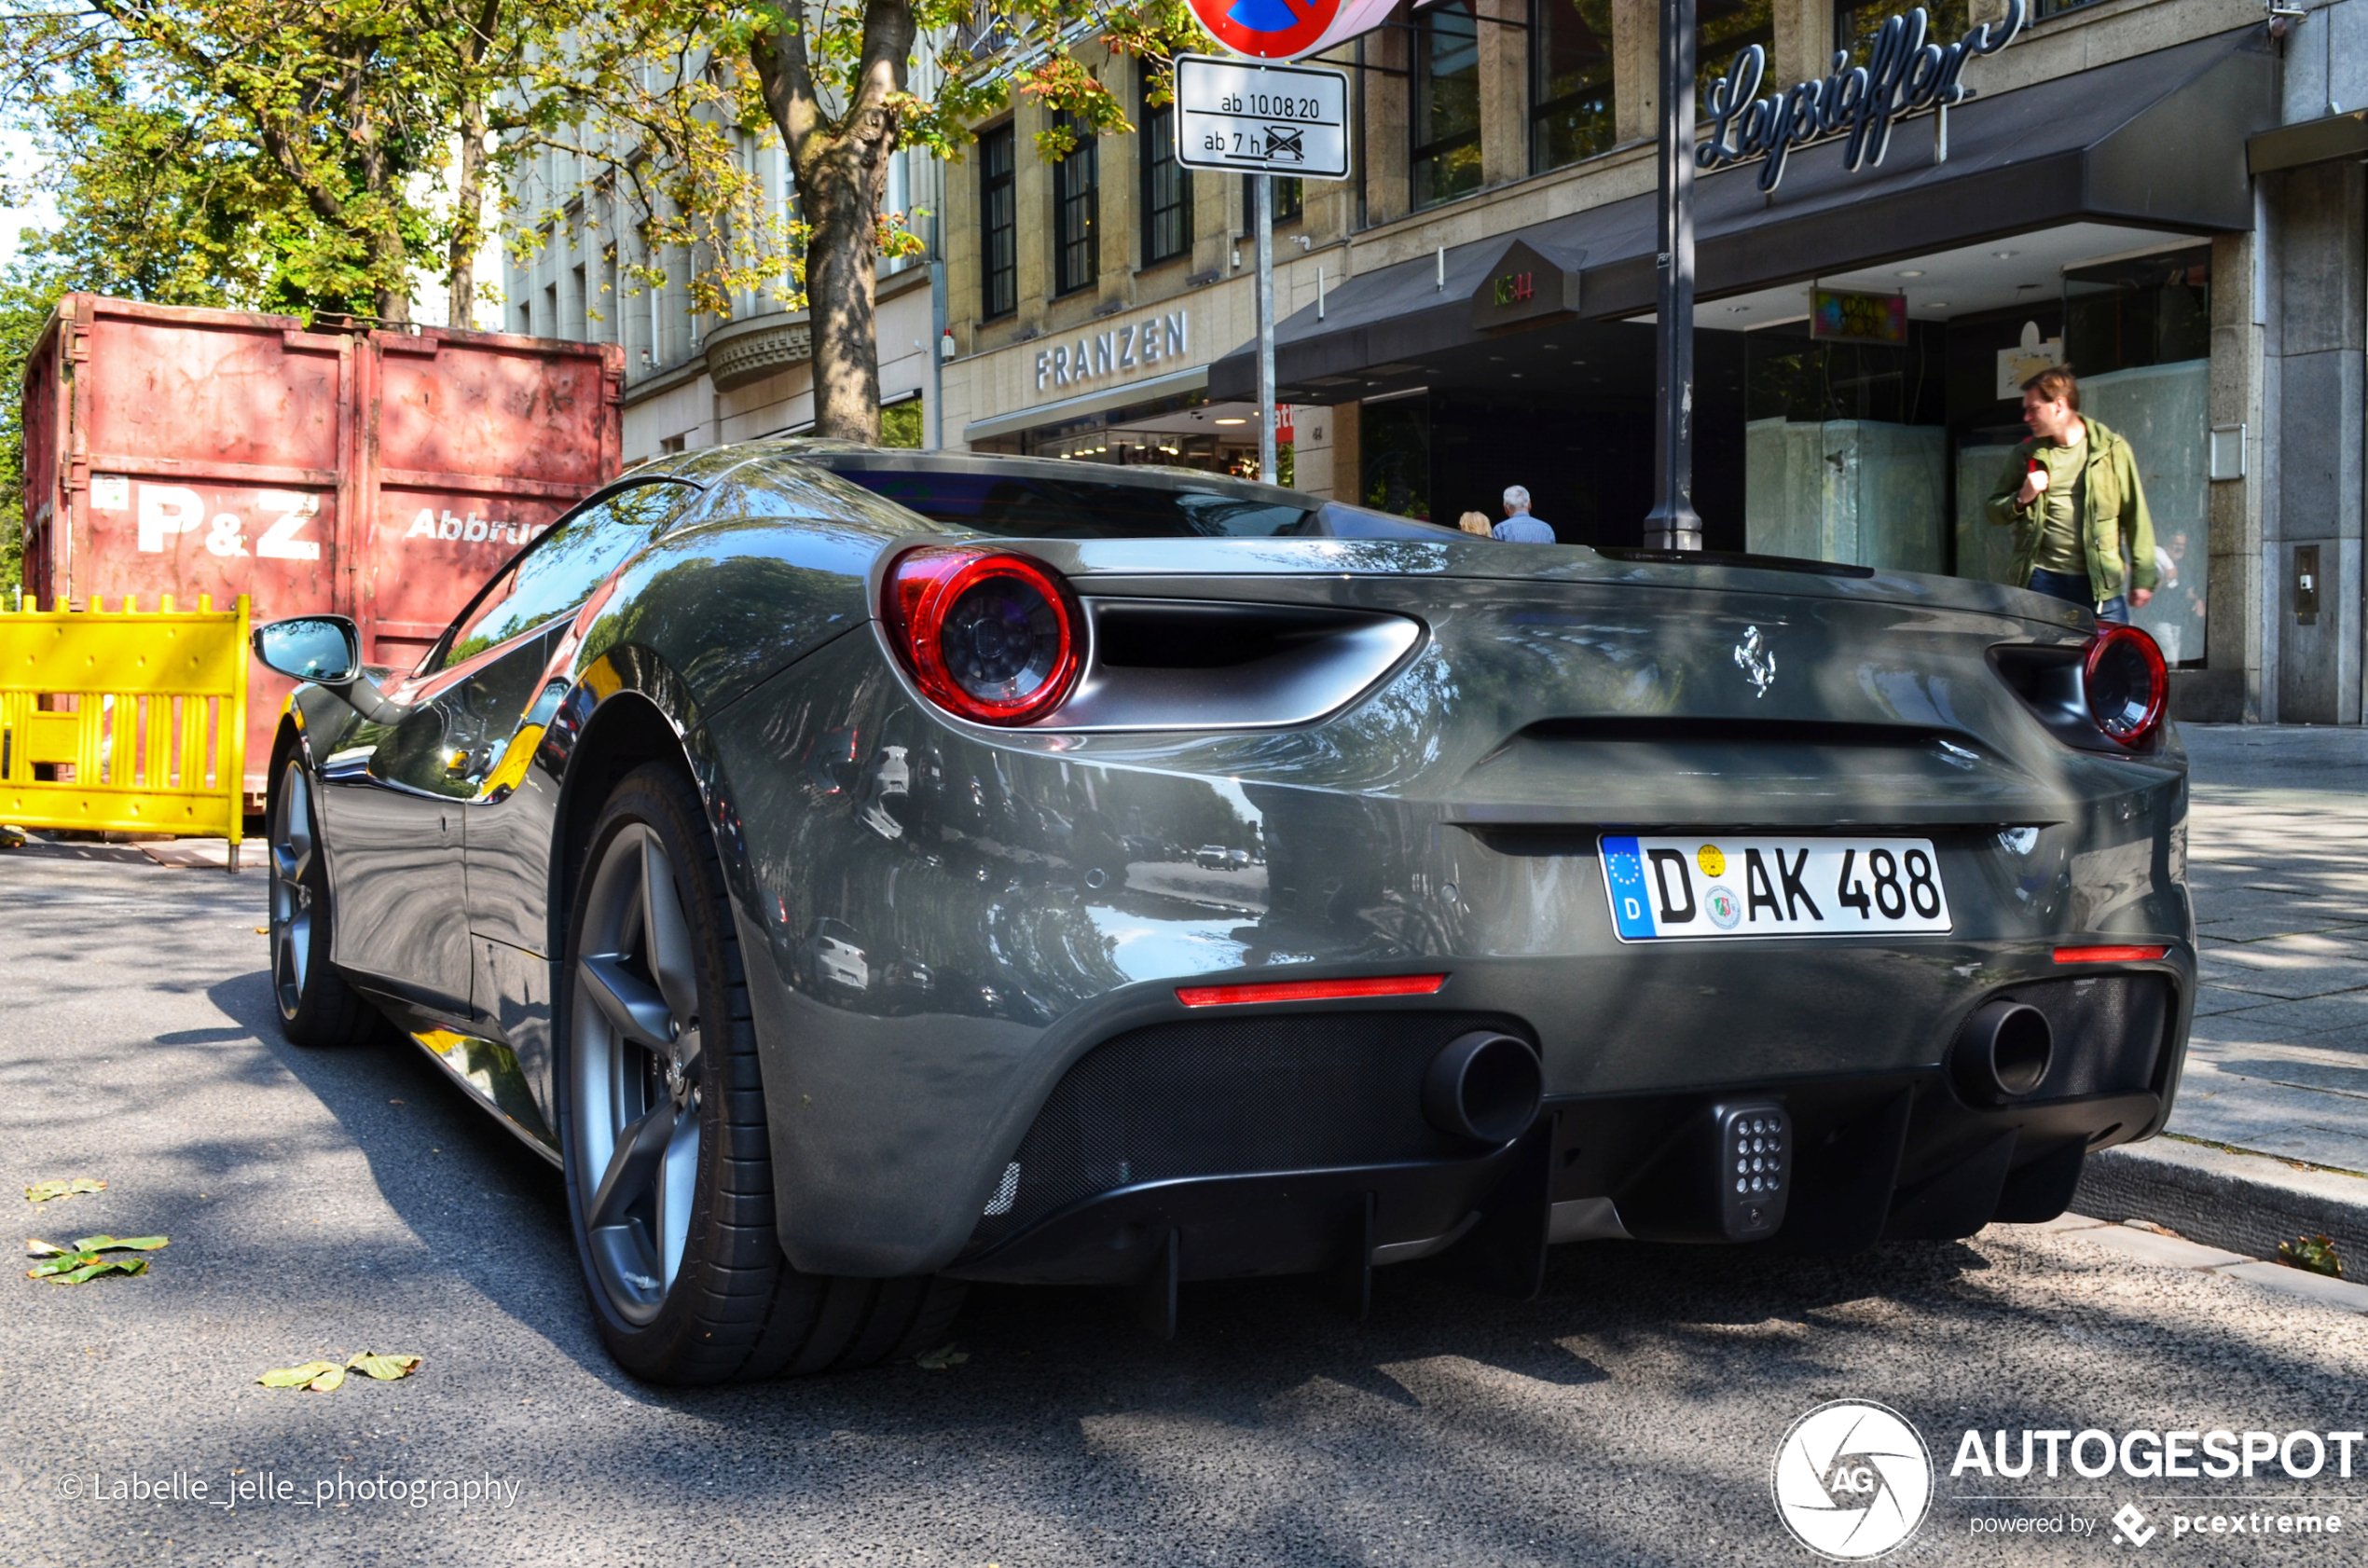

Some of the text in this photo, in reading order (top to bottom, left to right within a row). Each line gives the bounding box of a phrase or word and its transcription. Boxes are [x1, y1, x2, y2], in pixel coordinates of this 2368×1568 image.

[1221, 92, 1319, 118] ab 10.08.20
[1695, 0, 2026, 194] Leysieffer
[1204, 131, 1260, 155] ab 7 h
[1036, 310, 1187, 391] FRANZEN
[137, 484, 321, 560] P&Z
[1624, 898, 1641, 919] D
[1646, 847, 1697, 924] D
[1743, 847, 1824, 922] AK
[1837, 847, 1941, 920] 488
